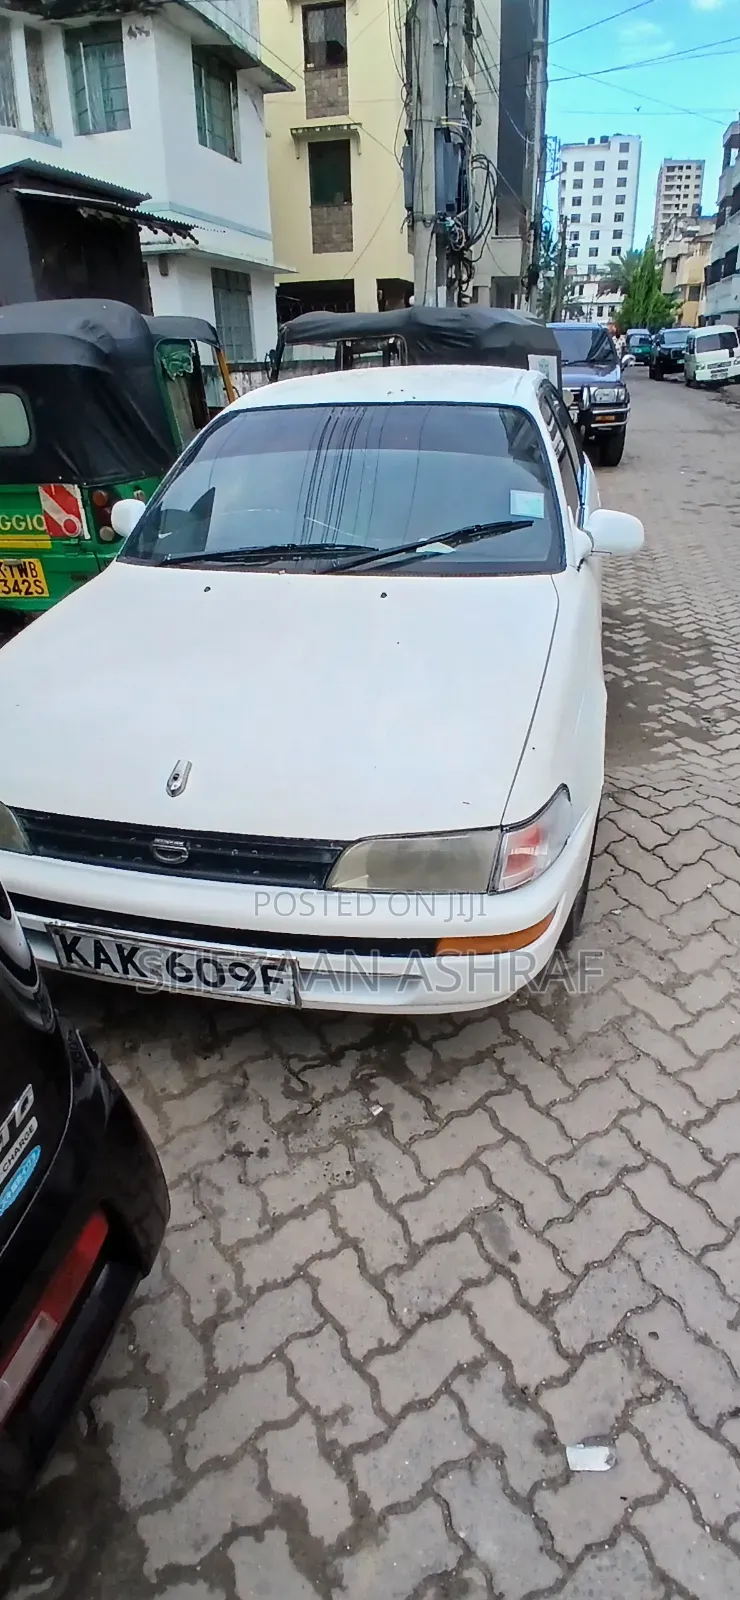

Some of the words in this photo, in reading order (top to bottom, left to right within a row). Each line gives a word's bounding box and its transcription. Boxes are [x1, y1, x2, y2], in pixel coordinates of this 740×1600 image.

[0, 579, 45, 596] 342S
[59, 934, 149, 978] KAK
[165, 951, 288, 995] 609F
